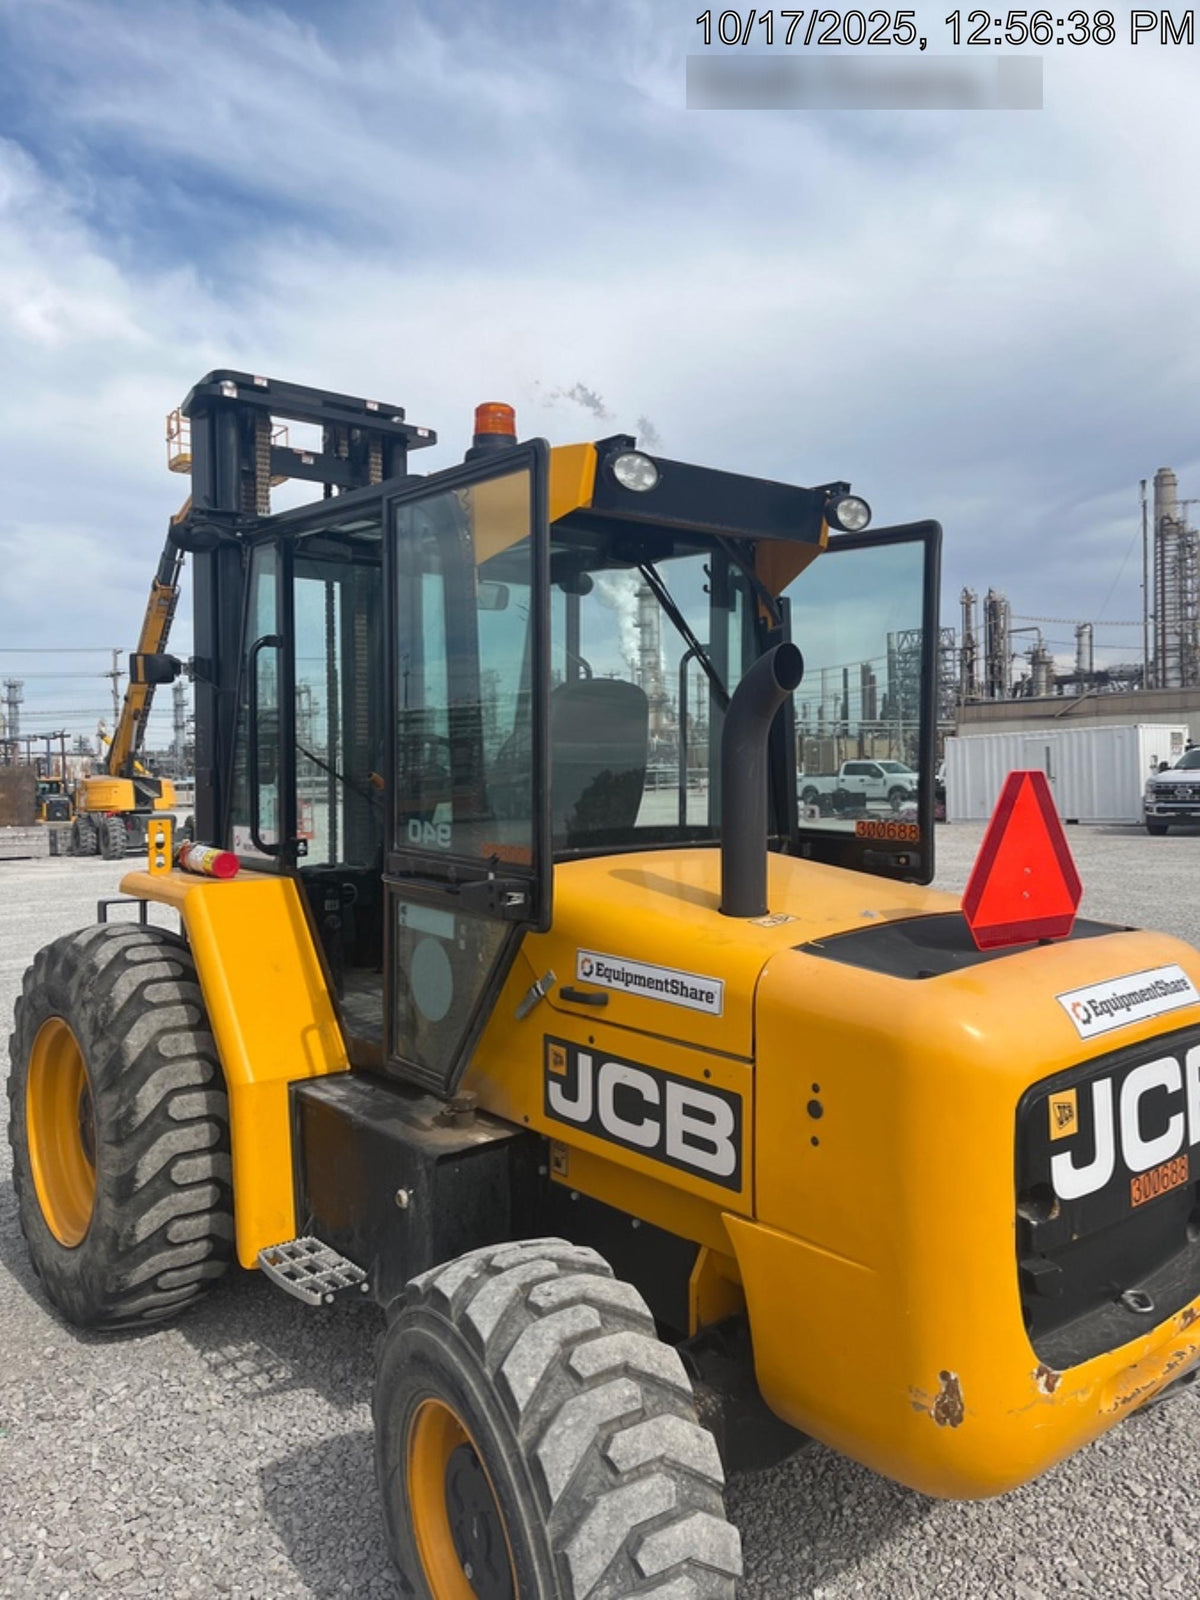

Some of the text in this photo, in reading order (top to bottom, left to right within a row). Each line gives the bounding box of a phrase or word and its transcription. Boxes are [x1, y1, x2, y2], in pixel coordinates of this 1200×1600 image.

[857, 821, 918, 840] 300688
[596, 962, 715, 1004] EquipmentShare
[1087, 978, 1191, 1018] EquipmentShare
[548, 1052, 736, 1176] JCB
[1051, 1045, 1200, 1200] JC
[1132, 1156, 1188, 1203] 300688
